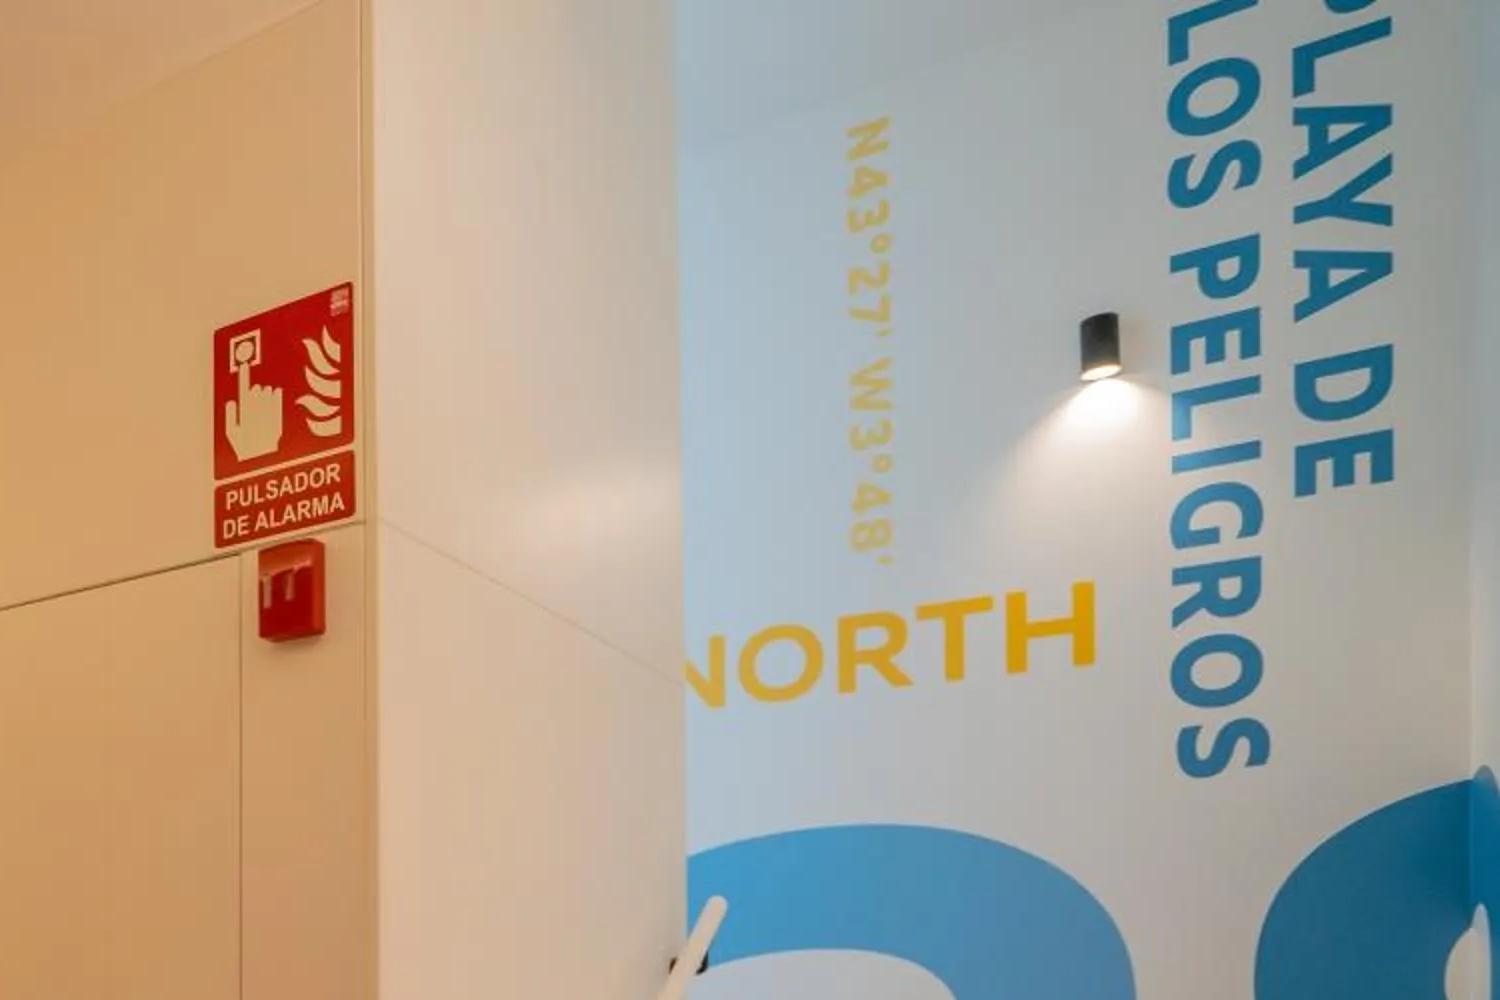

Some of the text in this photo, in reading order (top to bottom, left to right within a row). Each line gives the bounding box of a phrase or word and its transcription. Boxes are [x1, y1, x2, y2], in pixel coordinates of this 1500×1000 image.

[1292, 0, 1395, 499] LAYA DE
[222, 492, 345, 540] DE ALARMA
[225, 463, 341, 511] PULSADOR
[1167, 0, 1271, 780] LOS PELIGROS
